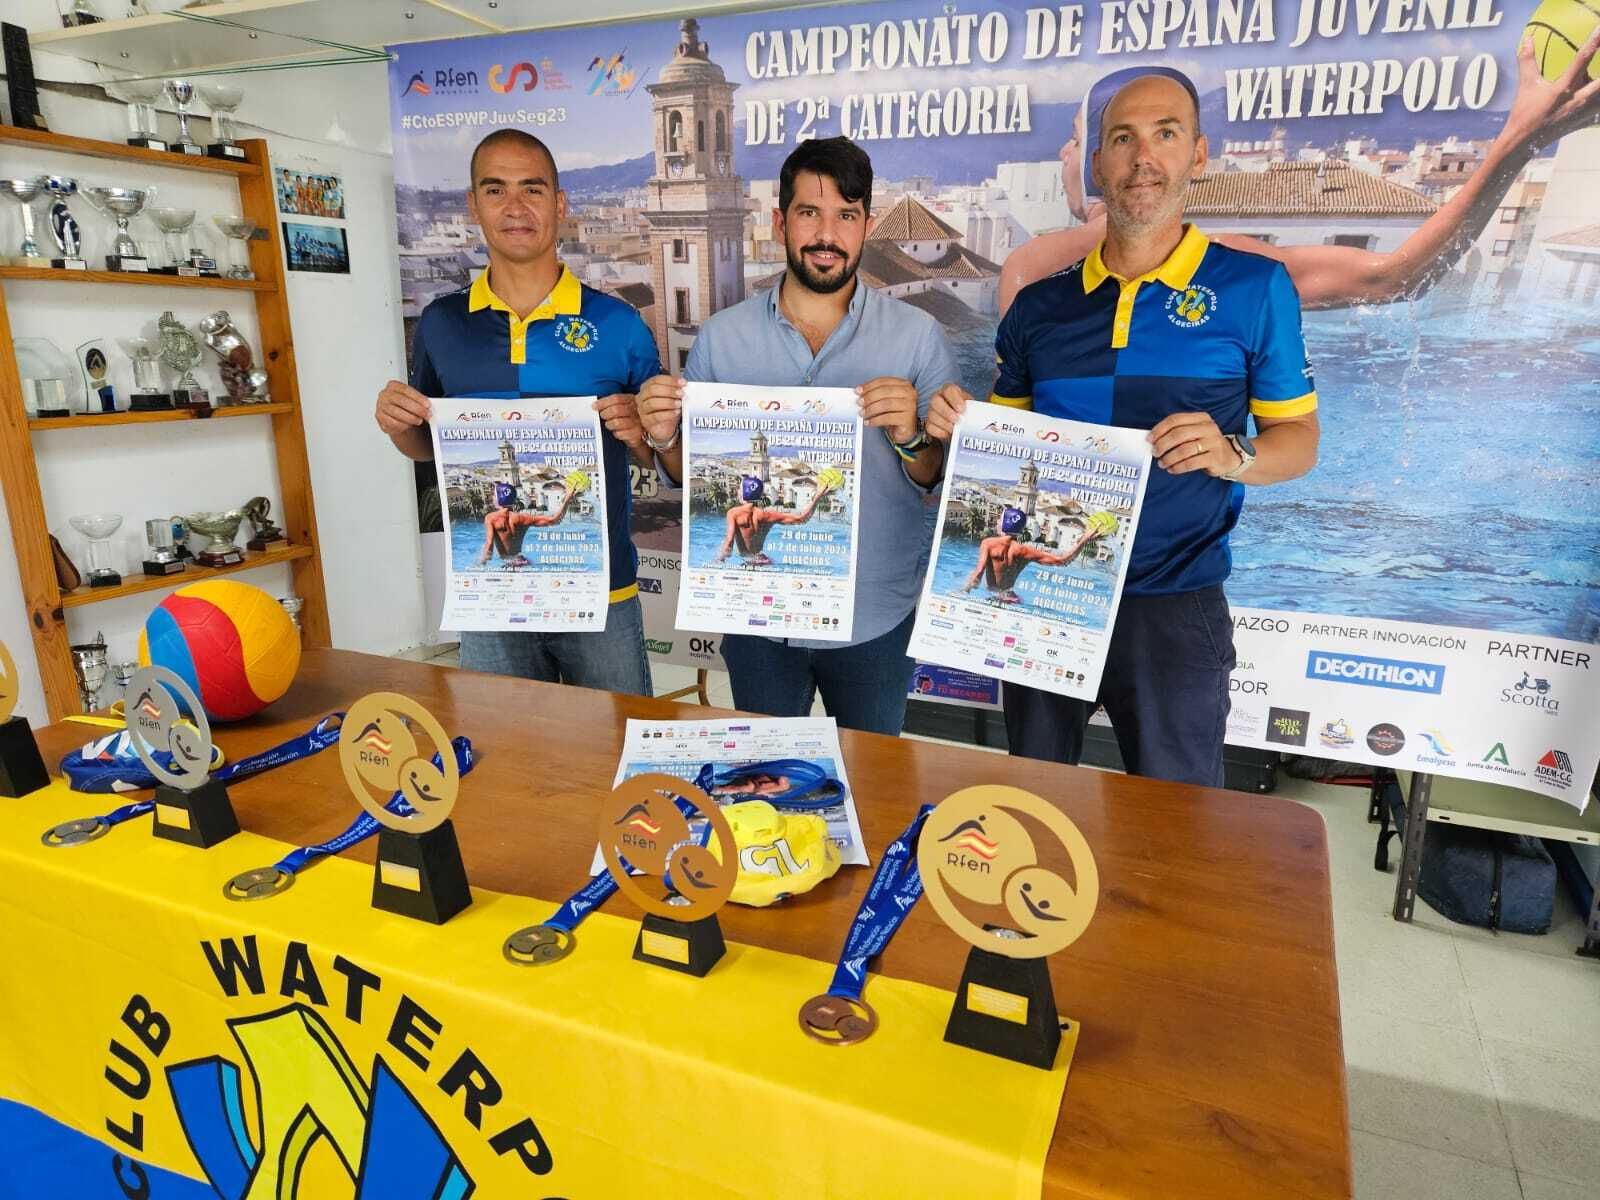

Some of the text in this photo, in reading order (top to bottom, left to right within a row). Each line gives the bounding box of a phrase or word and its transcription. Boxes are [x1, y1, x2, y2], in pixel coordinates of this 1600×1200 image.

[745, 11, 1009, 79] CAMPEONATO
[1023, 5, 1084, 60] DE
[1289, 0, 1504, 48] JUVENIL
[435, 68, 478, 87] Rfen
[1224, 53, 1498, 122] WATERPOLO
[401, 107, 567, 128] #CtoESPWPJuvSeg23
[745, 84, 1031, 146] DE 2ª CATEGORIA
[441, 428, 503, 440] CAMPEONATO
[505, 428, 520, 440] DE
[558, 428, 594, 440] JUVENIL
[693, 416, 757, 430] CAMPEONATO
[760, 418, 774, 432] DE
[816, 421, 855, 434] JUVENIL
[962, 436, 1031, 459] CAMPEONATO
[1032, 449, 1049, 463] DE
[1094, 460, 1137, 479] JUVENIL
[629, 464, 658, 497] 23
[690, 637, 715, 654] OK
[1302, 623, 1466, 650] PARTNER INNOVACIÓN
[1487, 641, 1591, 669] PARTNER
[1314, 657, 1436, 688] DECATHLON
[360, 750, 389, 767] Rfen
[622, 833, 657, 851] Rfen
[947, 852, 991, 875] Rfen
[103, 934, 572, 1200] CLUB WATERP
